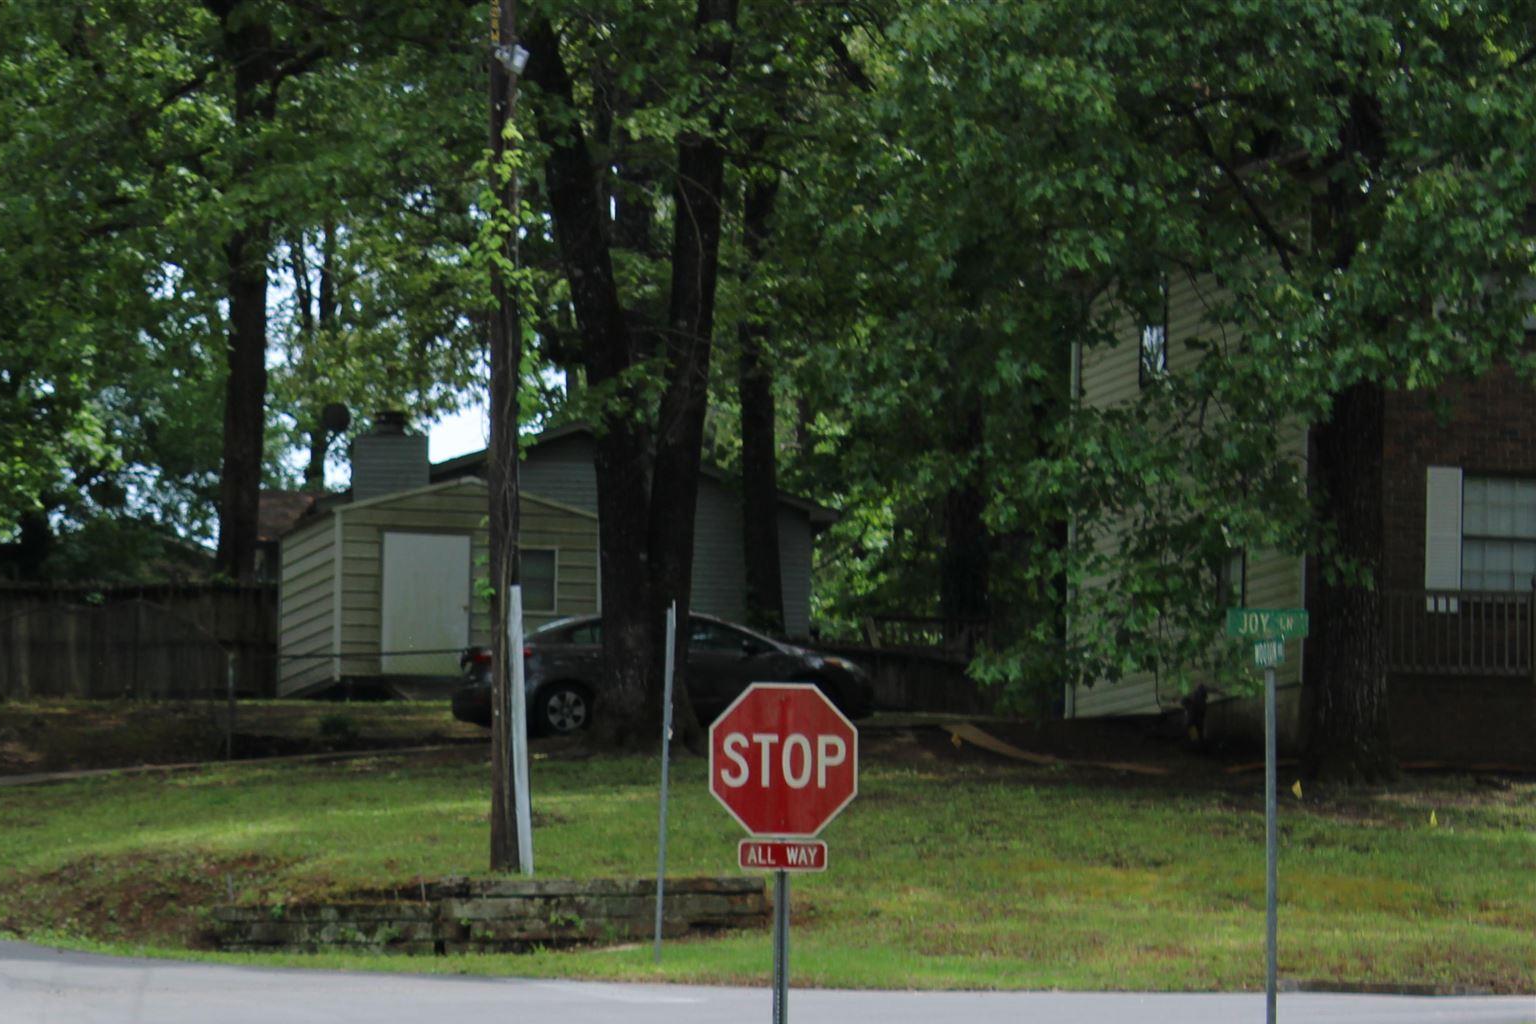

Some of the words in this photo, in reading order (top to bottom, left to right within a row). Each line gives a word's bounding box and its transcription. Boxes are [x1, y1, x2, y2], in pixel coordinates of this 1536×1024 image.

[1238, 612, 1269, 634] JOY
[720, 731, 847, 789] STOP
[747, 845, 776, 865] ALL
[786, 845, 818, 865] WAY
